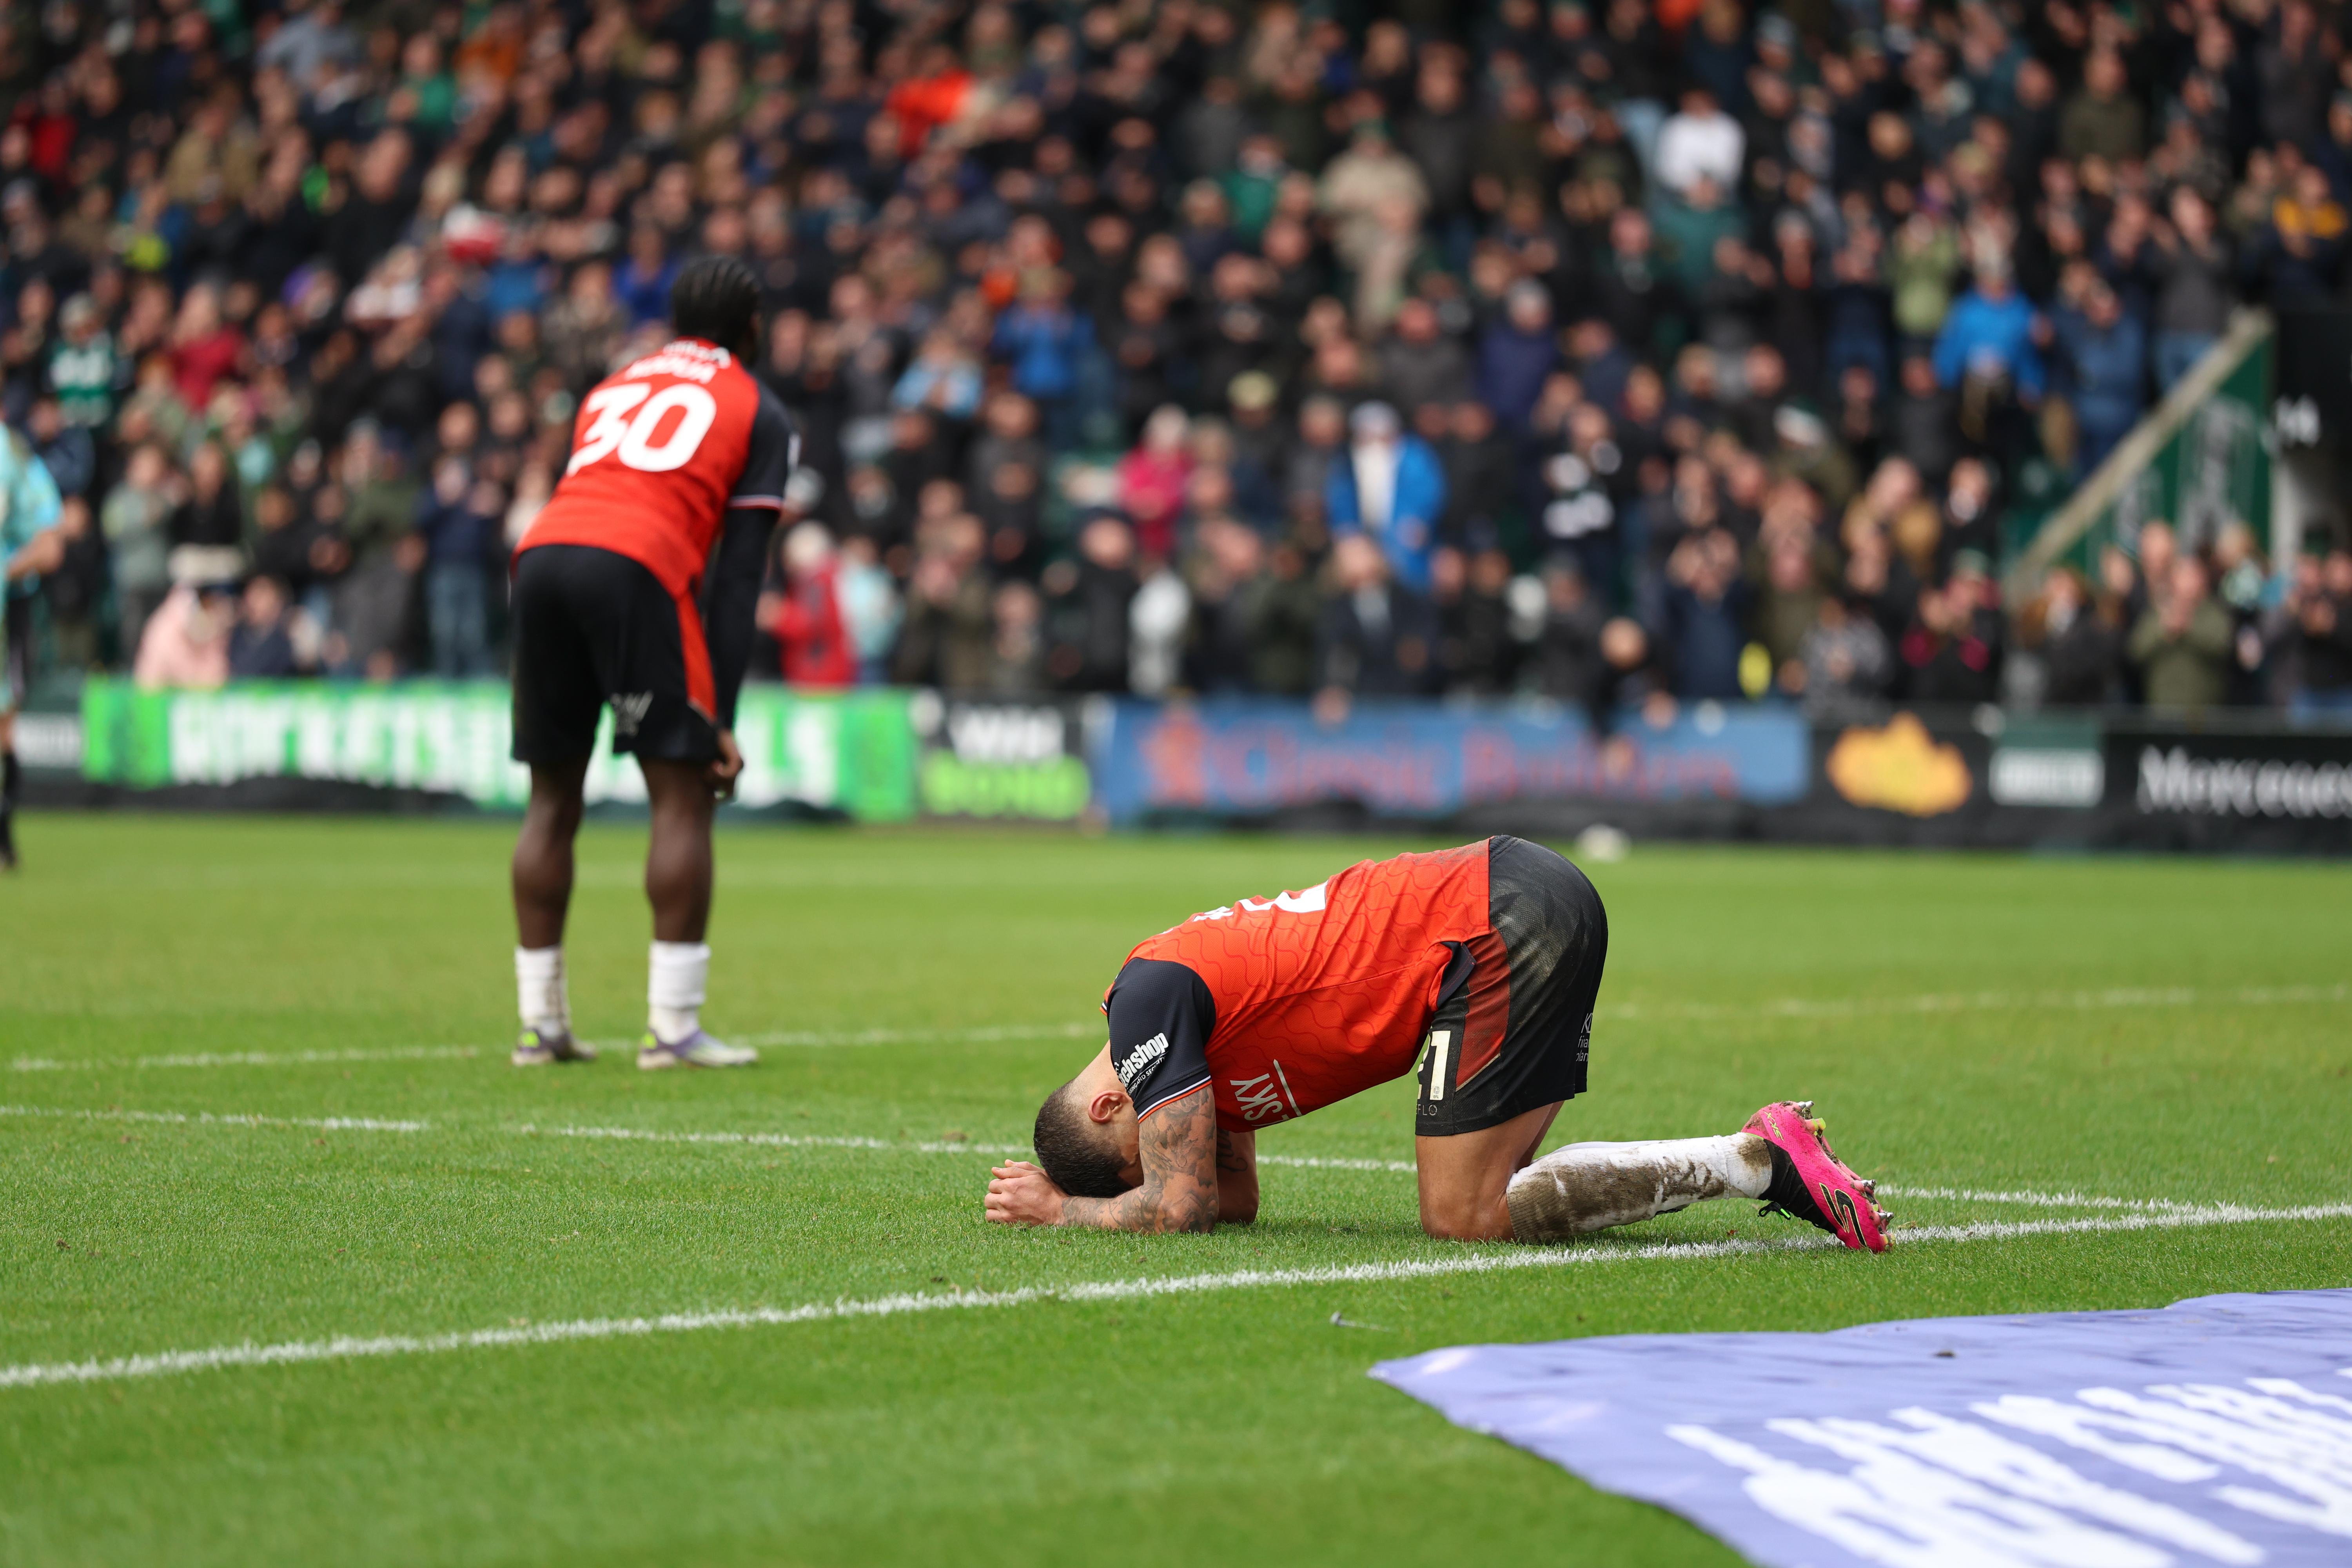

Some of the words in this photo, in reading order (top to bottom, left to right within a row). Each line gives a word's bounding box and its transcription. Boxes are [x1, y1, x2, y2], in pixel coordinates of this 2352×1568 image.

[567, 383, 717, 477] 30
[1578, 1035, 1590, 1048] fina
[1230, 1073, 1290, 1126] SKY
